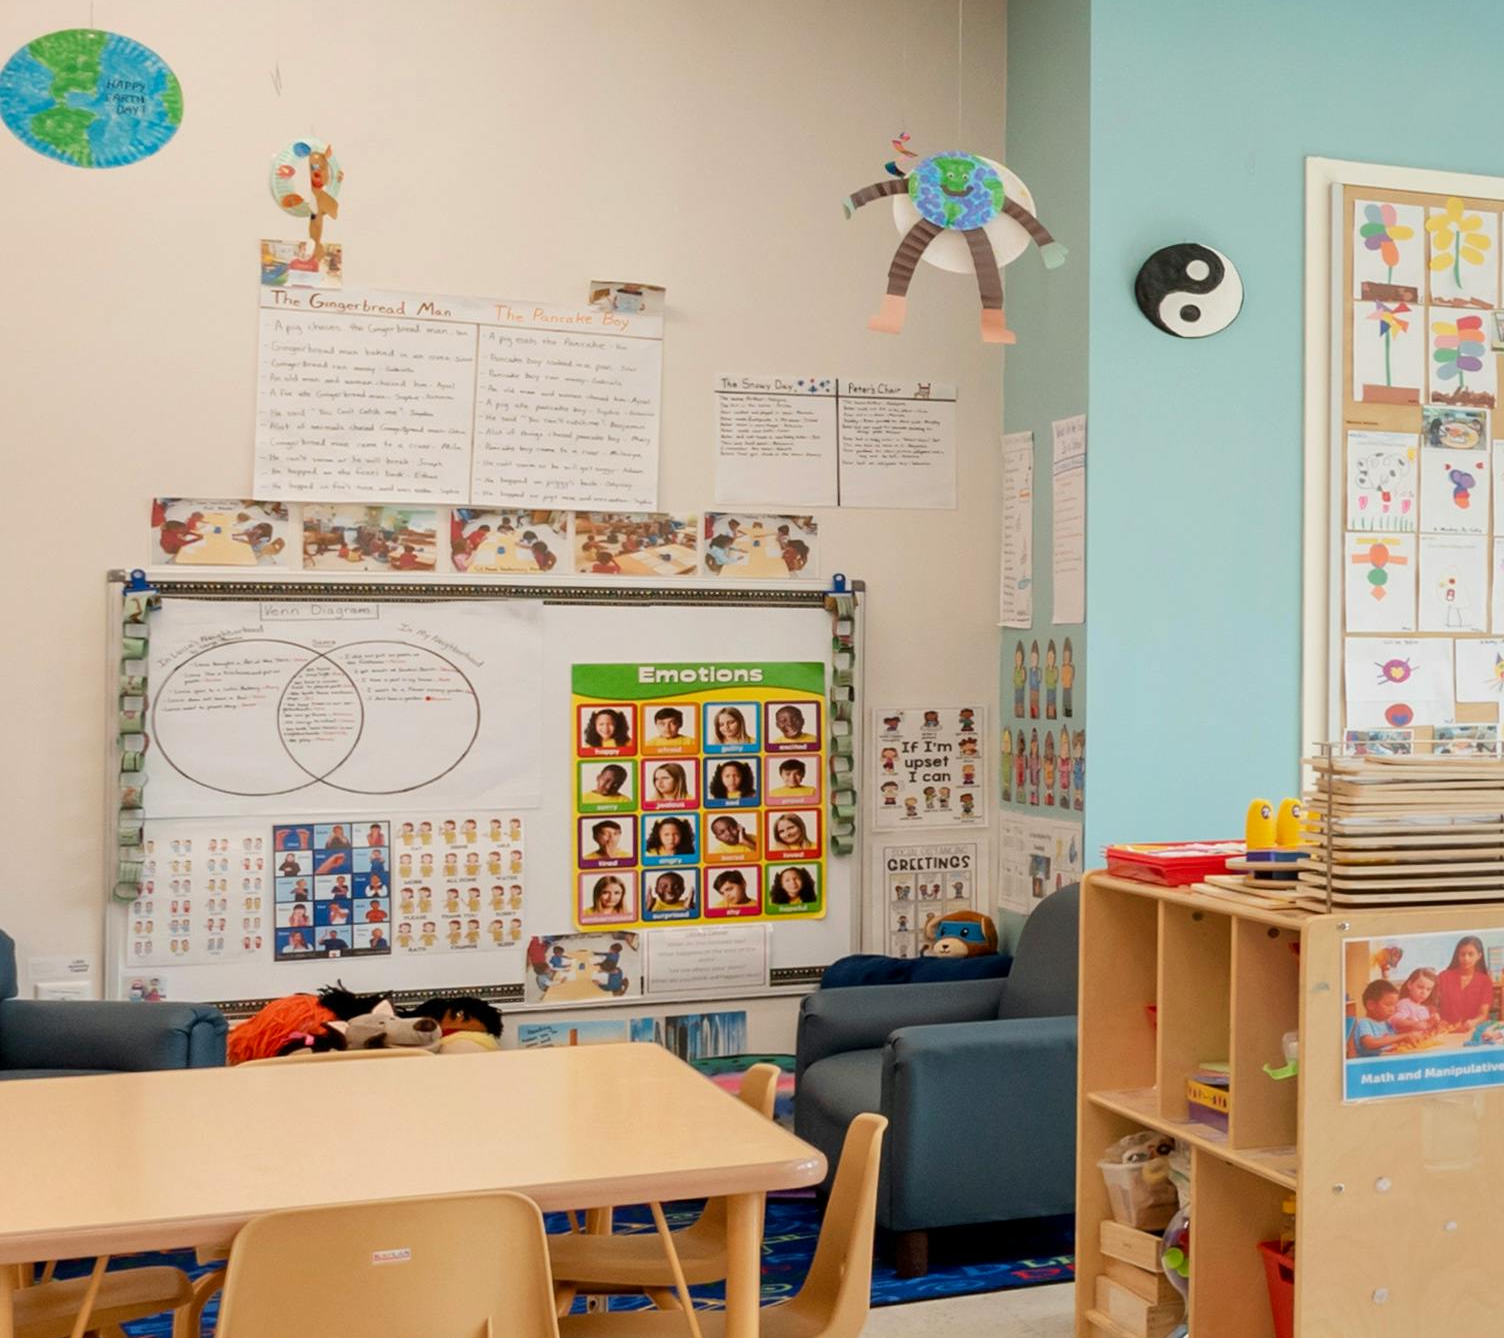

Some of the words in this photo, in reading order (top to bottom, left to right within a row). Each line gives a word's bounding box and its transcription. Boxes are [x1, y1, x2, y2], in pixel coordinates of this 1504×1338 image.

[106, 80, 145, 93] HAPPY
[271, 289, 300, 307] The
[309, 293, 406, 315] Gingerbread
[416, 301, 452, 317] Man
[493, 304, 524, 323] The
[532, 307, 592, 325] Pancake
[602, 311, 629, 331] Boy
[721, 378, 738, 389] The
[742, 379, 770, 391] Snowy
[775, 379, 793, 392] Day
[878, 383, 902, 395] Chair
[264, 605, 299, 617] Venn
[311, 605, 372, 619] Diagram
[637, 666, 763, 683] Emotions
[595, 747, 620, 755] happy
[779, 743, 808, 751] excited
[901, 741, 918, 753] If
[924, 741, 952, 752] I'm
[904, 756, 949, 770] upset
[908, 771, 917, 783] I
[923, 772, 951, 782] can
[783, 851, 805, 859] loved
[598, 859, 618, 867] tired
[887, 856, 970, 871] GREETINGS
[652, 911, 690, 921] surprised
[1361, 1072, 1395, 1085] Math
[1398, 1069, 1421, 1080] and
